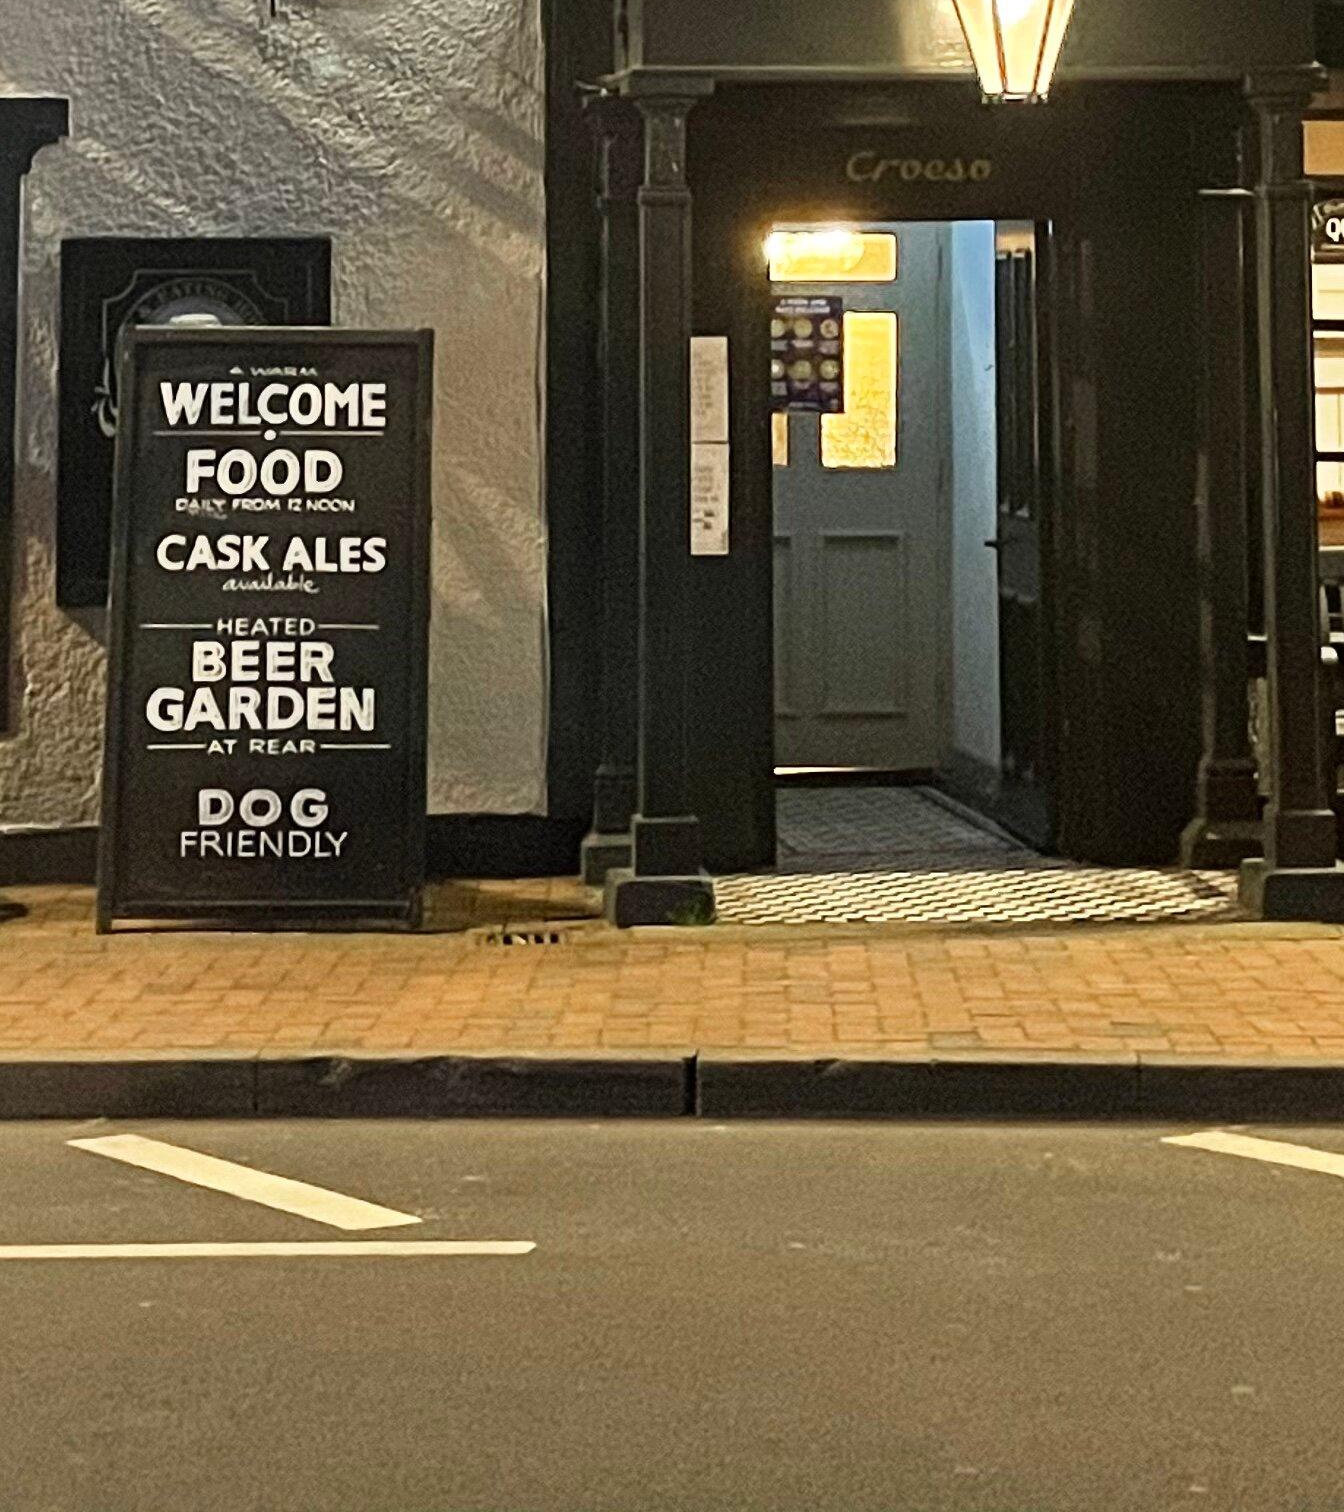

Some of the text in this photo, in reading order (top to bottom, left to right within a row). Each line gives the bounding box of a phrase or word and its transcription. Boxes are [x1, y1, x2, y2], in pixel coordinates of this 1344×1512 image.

[846, 150, 992, 182] Croeso
[250, 366, 319, 377] WARM
[159, 381, 387, 428] WELCOME
[186, 448, 343, 496] FOOD
[175, 497, 227, 513] DAILY
[232, 498, 281, 512] FROM
[307, 498, 355, 513] NOON
[156, 534, 387, 573] CASK ALES
[222, 573, 319, 594] available
[216, 617, 316, 636] HEATED
[192, 640, 334, 682] BEER
[145, 686, 375, 732] GARDEN
[207, 739, 316, 755] AT REAR
[198, 788, 329, 828] DOG
[180, 830, 348, 858] FRIENDLY
